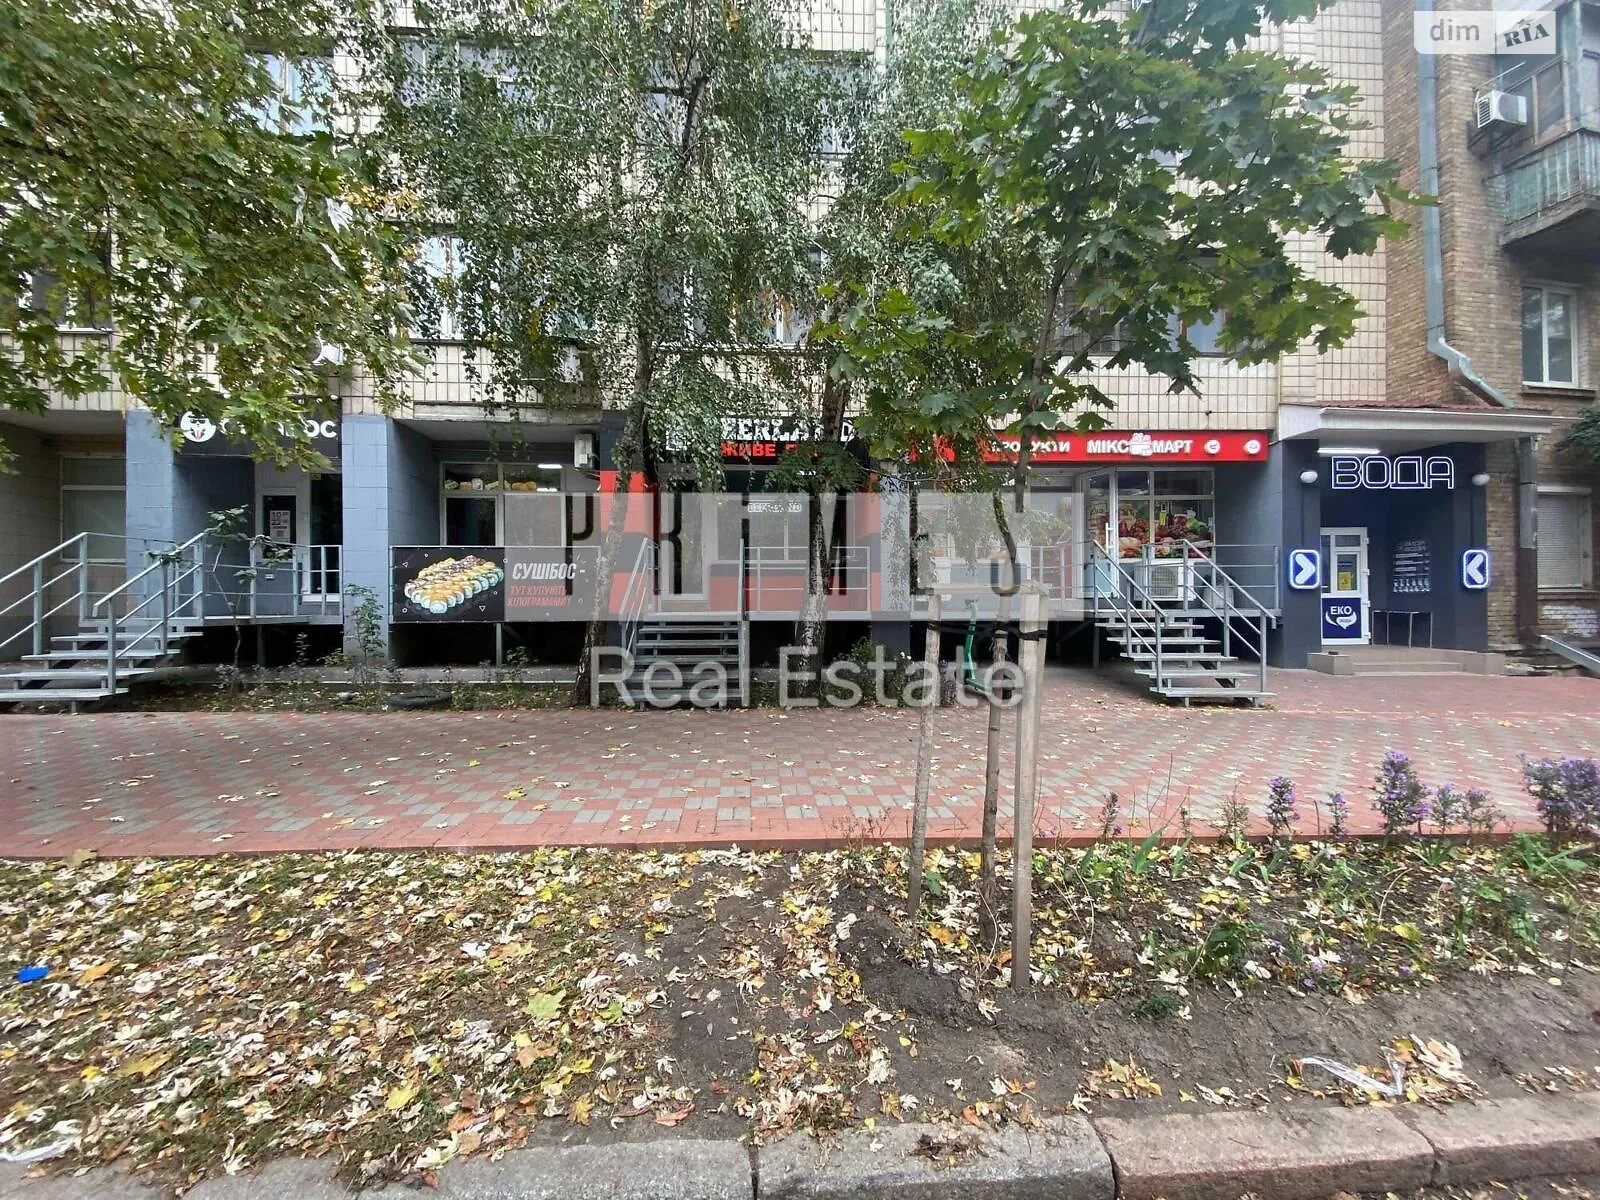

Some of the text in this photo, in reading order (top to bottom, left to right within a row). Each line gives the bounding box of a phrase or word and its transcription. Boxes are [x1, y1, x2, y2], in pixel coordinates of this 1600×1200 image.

[1087, 439, 1129, 454] МІКС
[1152, 439, 1193, 454] МАРТ
[1331, 455, 1454, 490] ВОДА
[512, 563, 577, 580] СУШІБОС
[1330, 606, 1352, 615] ЕКО
